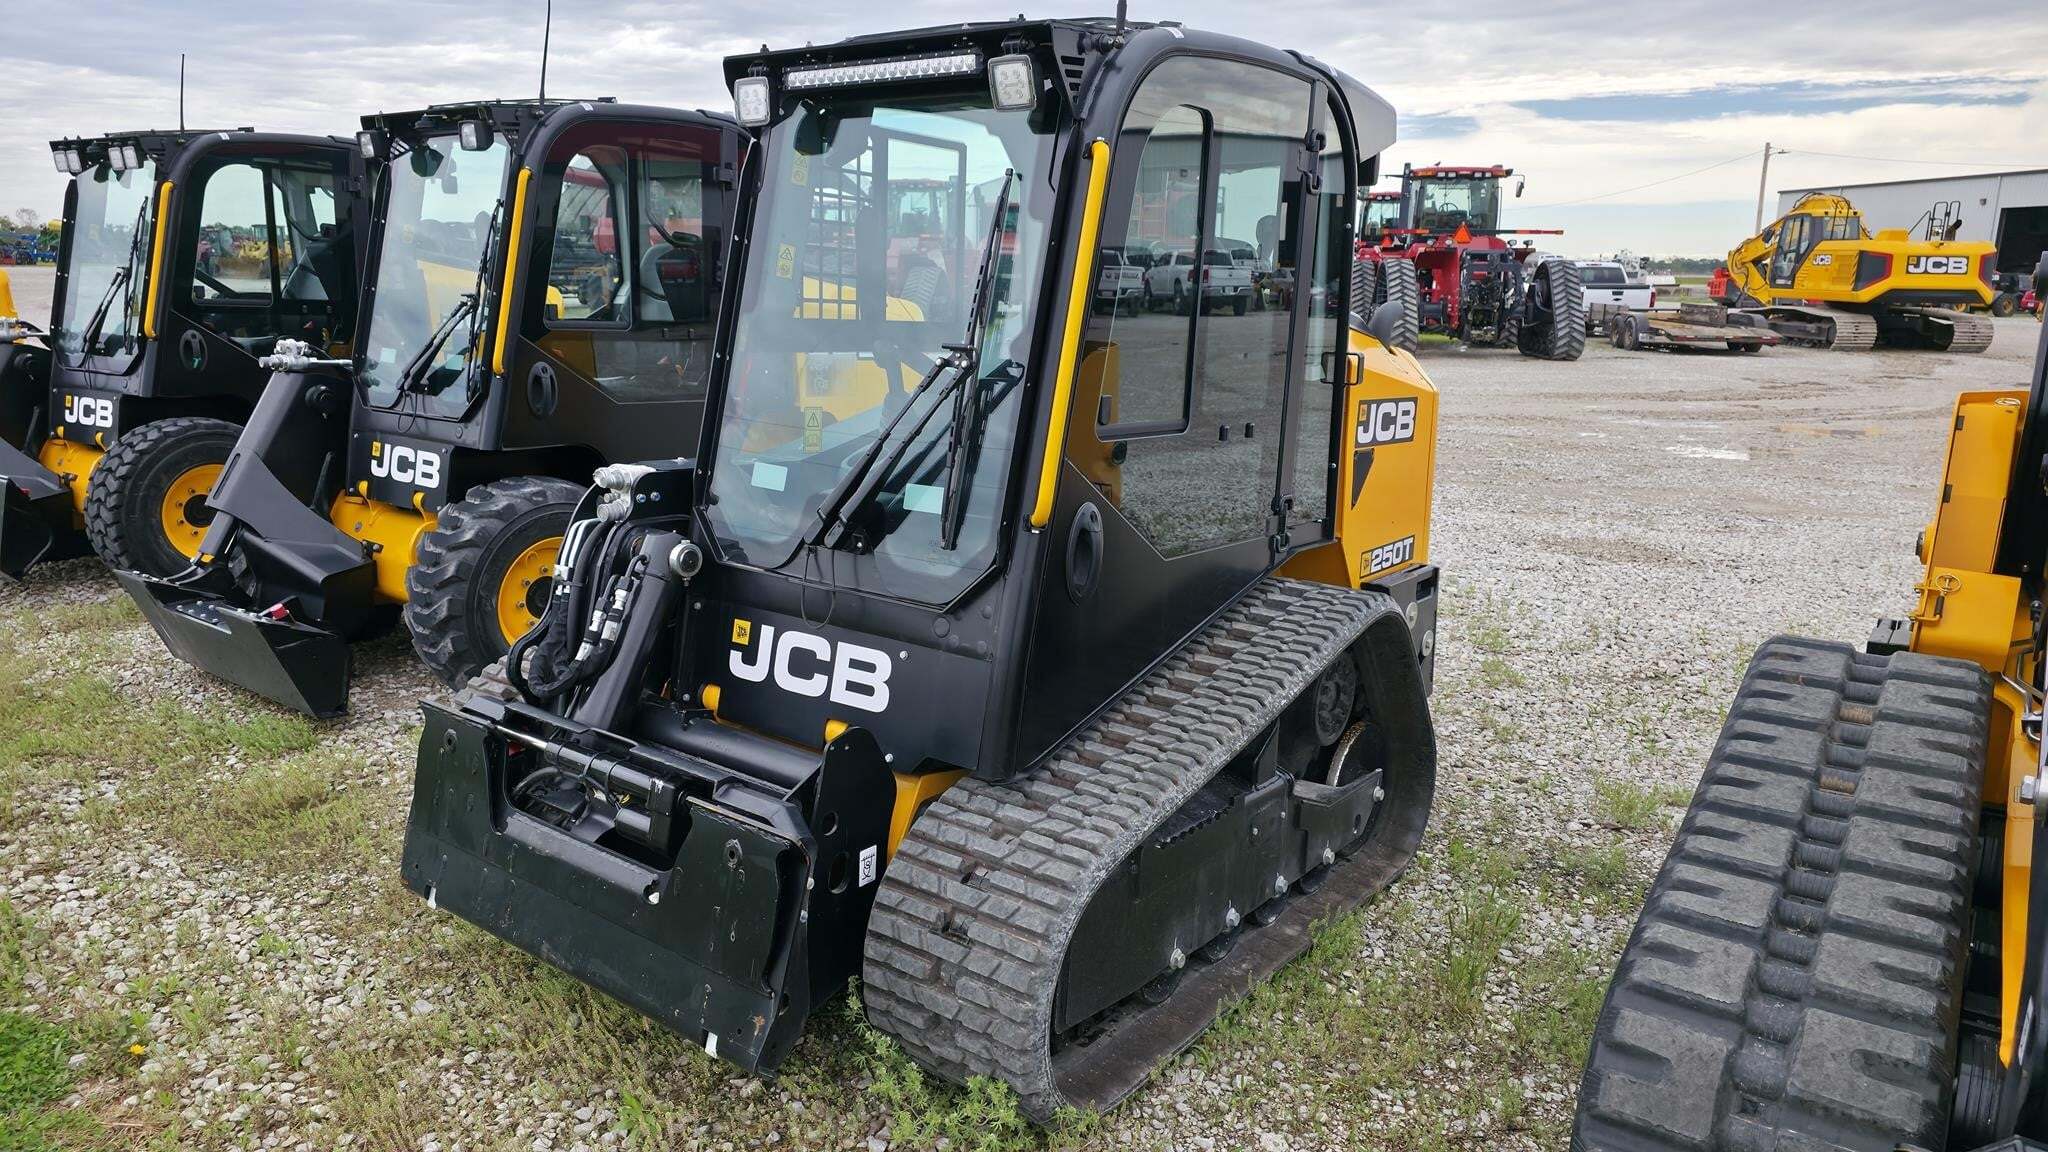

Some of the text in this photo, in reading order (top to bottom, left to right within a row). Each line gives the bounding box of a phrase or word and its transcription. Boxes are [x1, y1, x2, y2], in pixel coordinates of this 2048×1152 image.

[1813, 254, 1832, 265] JCB
[1907, 256, 1968, 274] JCB
[64, 395, 113, 428] JCB
[1357, 401, 1416, 444] JCB
[370, 443, 441, 489] JCB
[1370, 537, 1414, 573] 250T
[729, 624, 892, 713] JCB
